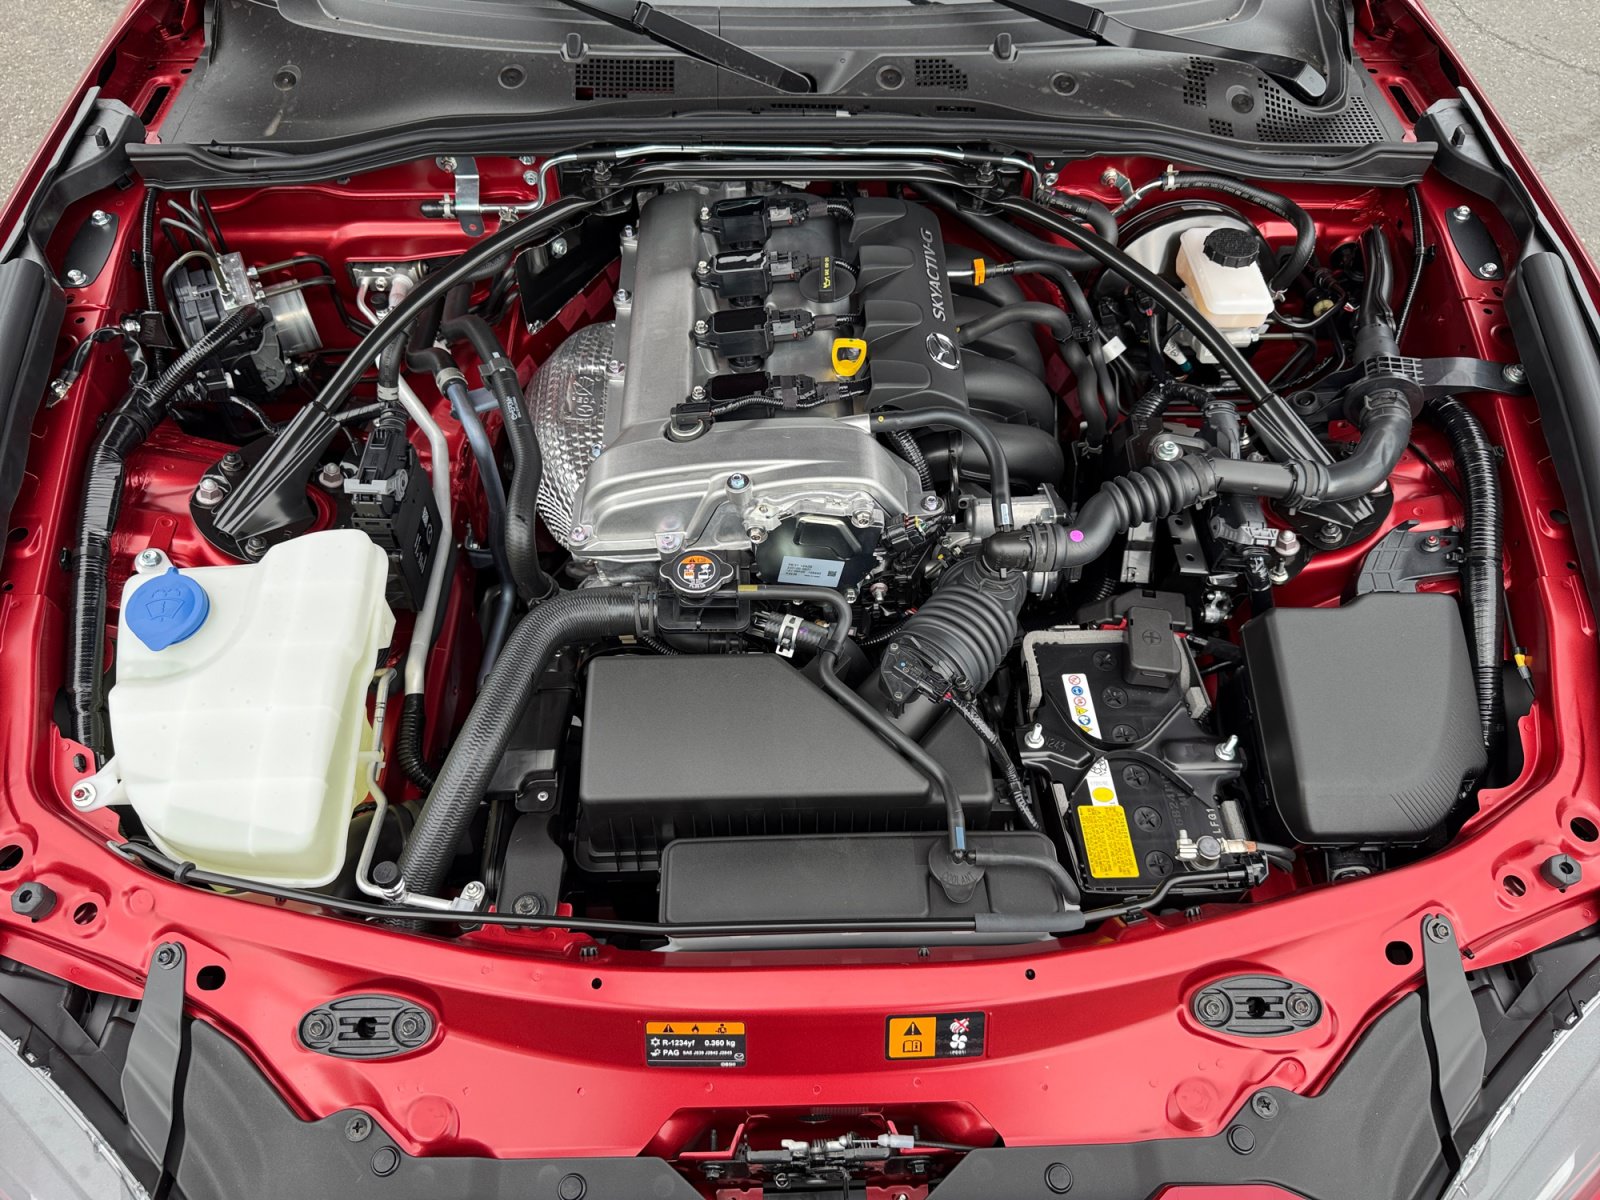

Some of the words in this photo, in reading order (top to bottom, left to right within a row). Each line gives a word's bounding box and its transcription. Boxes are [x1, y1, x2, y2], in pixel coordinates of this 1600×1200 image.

[920, 227, 946, 322] SKYACTIV-G
[1205, 808, 1222, 834] LFG1
[662, 1039, 695, 1048] R-1234yf
[726, 1039, 736, 1048] kg
